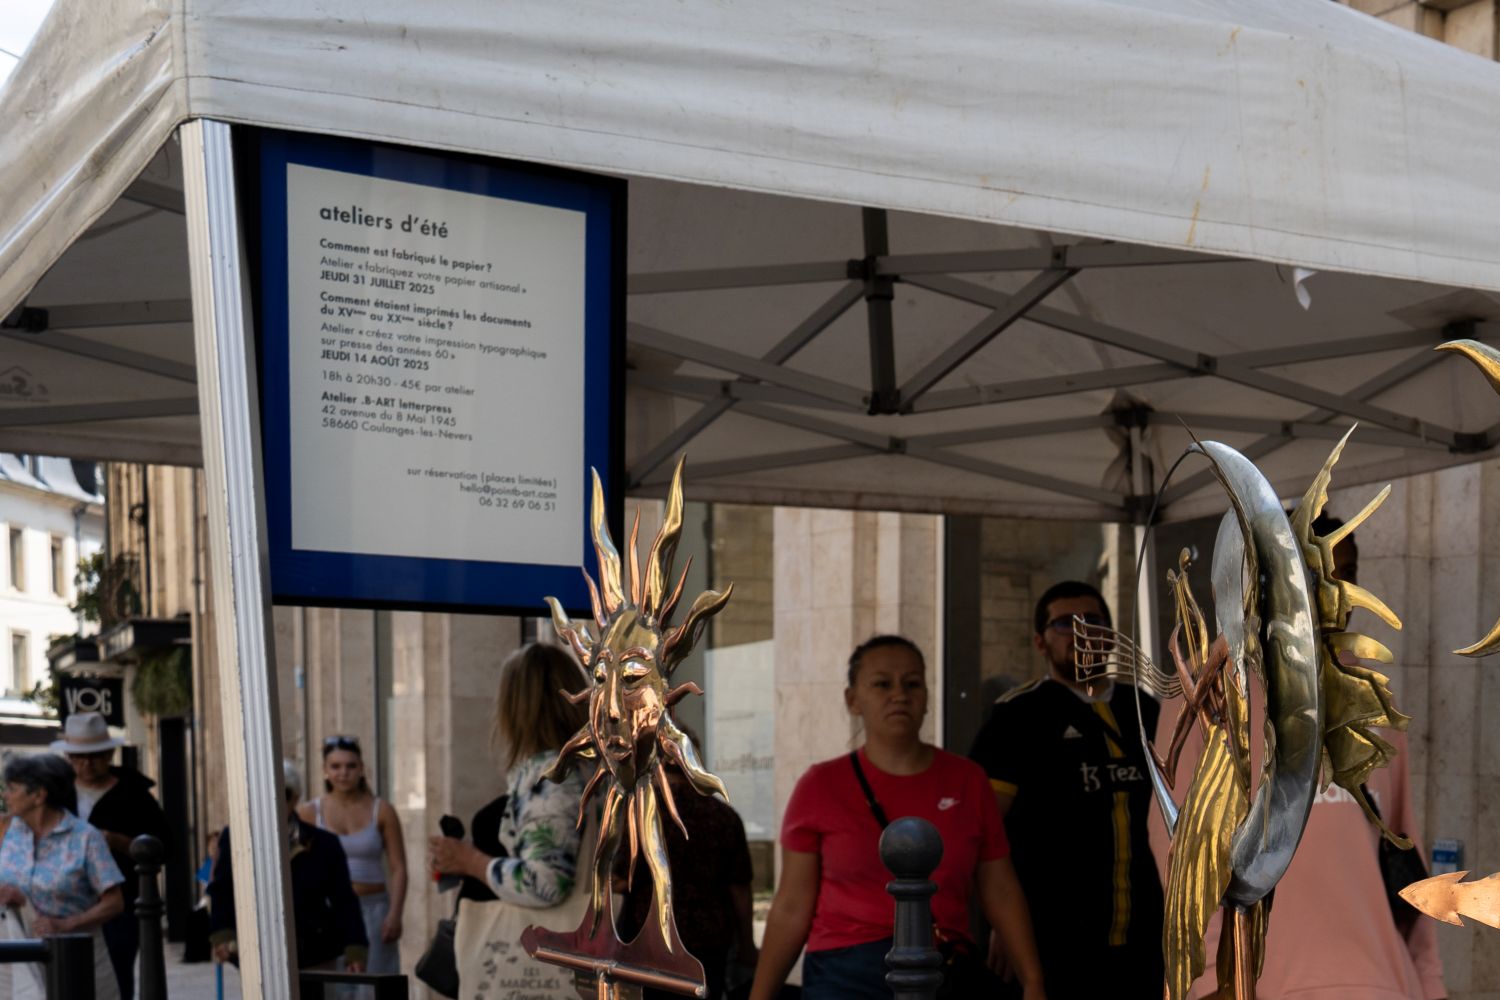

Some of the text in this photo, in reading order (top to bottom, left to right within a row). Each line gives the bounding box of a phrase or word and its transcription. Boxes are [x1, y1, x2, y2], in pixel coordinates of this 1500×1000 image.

[320, 205, 448, 238] ateliers d'été
[320, 238, 370, 254] Comment
[374, 248, 389, 257] est
[392, 247, 435, 265] fabriqué
[440, 255, 448, 266] le
[320, 256, 354, 269] Atelier
[417, 271, 441, 282] votre
[445, 275, 476, 287] papier
[320, 270, 435, 295] JEUDI 31 JUILLET 2025
[320, 291, 532, 329] Comment étaient imprimés les documents
[320, 304, 334, 315] du
[370, 313, 383, 321] au
[320, 322, 355, 335] Atelier
[397, 333, 421, 343] votre
[425, 336, 476, 350] impression
[479, 342, 547, 360] typographique
[320, 338, 336, 346] sur
[340, 339, 372, 350] presse
[375, 341, 393, 353] des
[397, 346, 432, 357] années
[320, 349, 429, 371] JEUDI 14 AOÛT 2025
[322, 370, 342, 382] 18h
[346, 373, 352, 383] à
[356, 374, 391, 387] 20h30
[401, 379, 421, 391] 45€
[425, 384, 441, 393] par
[444, 385, 475, 396] atelier
[321, 391, 357, 404] Atelier
[399, 399, 452, 414] letterpress
[321, 404, 457, 427] 42 avenue du 8 Mai 1945
[321, 417, 358, 430] 58660
[407, 467, 421, 476] sur
[425, 467, 478, 480] réservation
[518, 474, 557, 489] limitées)
[478, 496, 556, 512] 06 32 69 06 51
